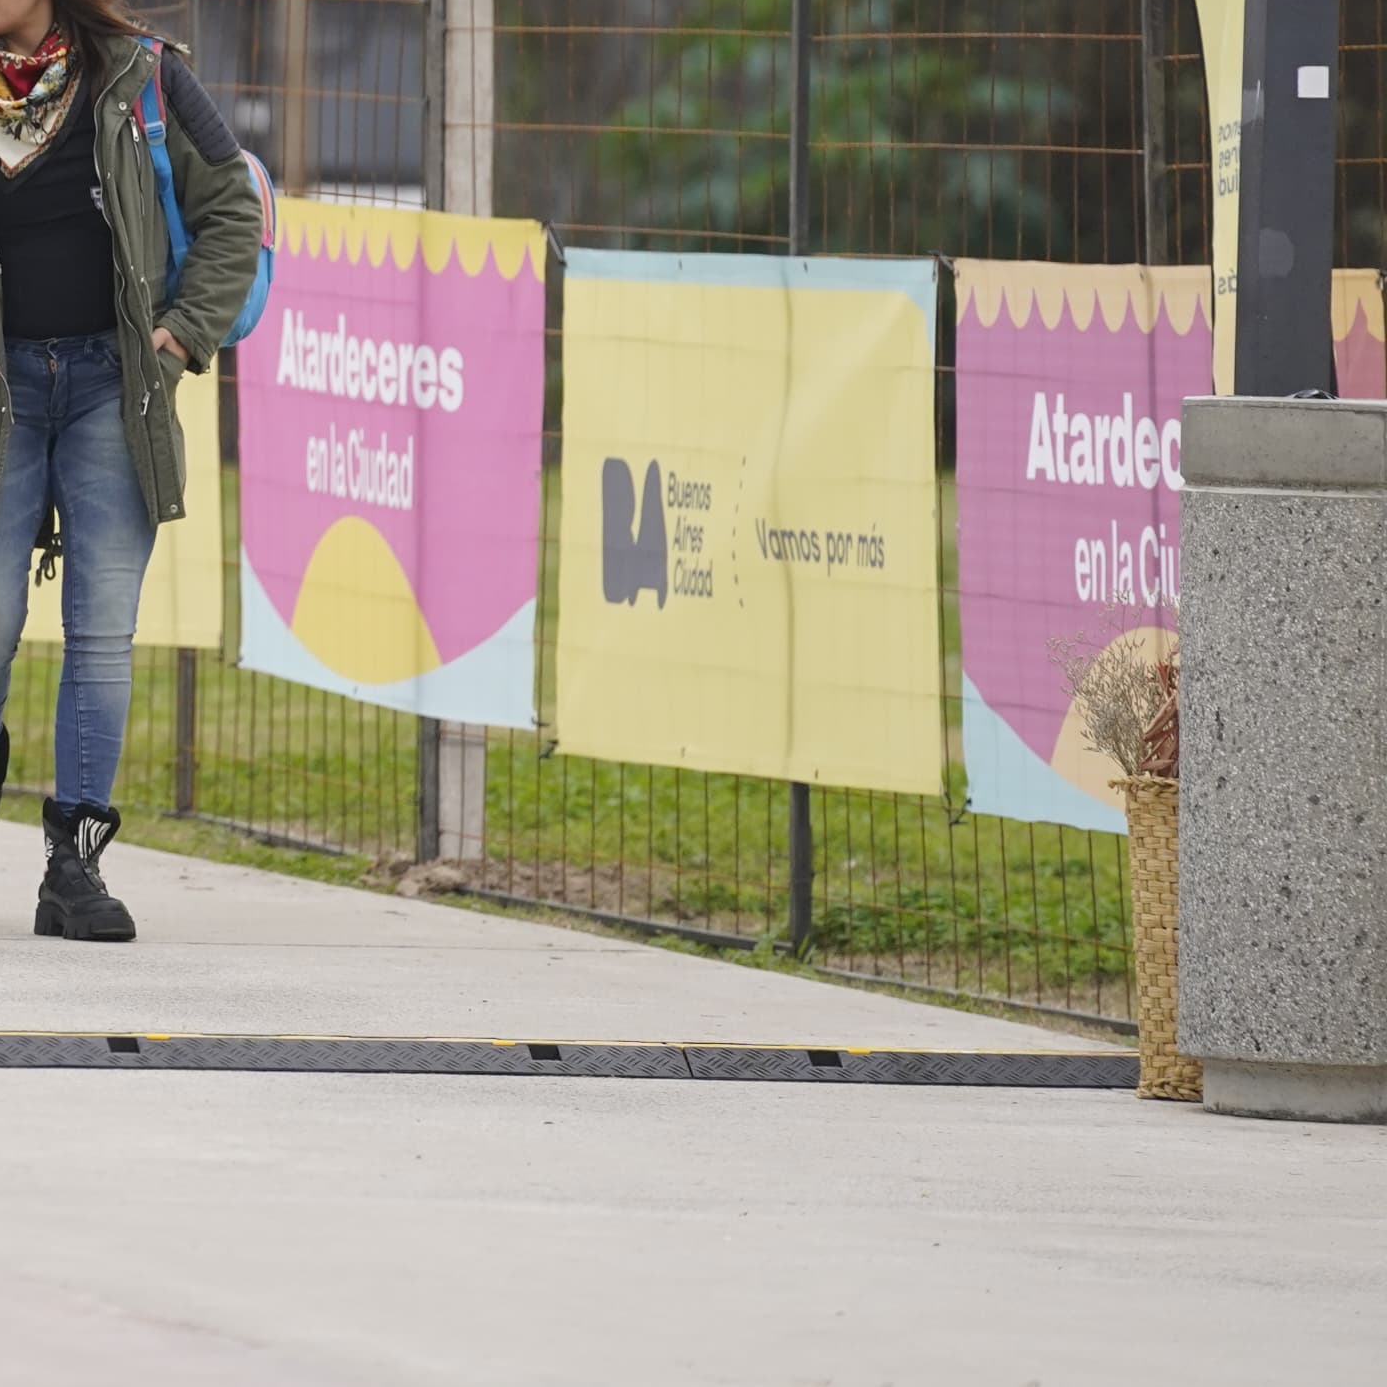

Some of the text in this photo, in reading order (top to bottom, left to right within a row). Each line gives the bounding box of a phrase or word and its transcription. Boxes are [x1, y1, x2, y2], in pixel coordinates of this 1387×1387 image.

[277, 308, 464, 412] Atardeceres
[306, 421, 414, 510] en la Ciudad
[1026, 392, 1182, 491] Atardec
[667, 471, 711, 511] Buenos
[672, 515, 704, 553] Aires
[755, 517, 885, 578] Vamos por más
[1074, 537, 1107, 603] en
[1111, 519, 1136, 606] la
[673, 559, 713, 598] Ciudad
